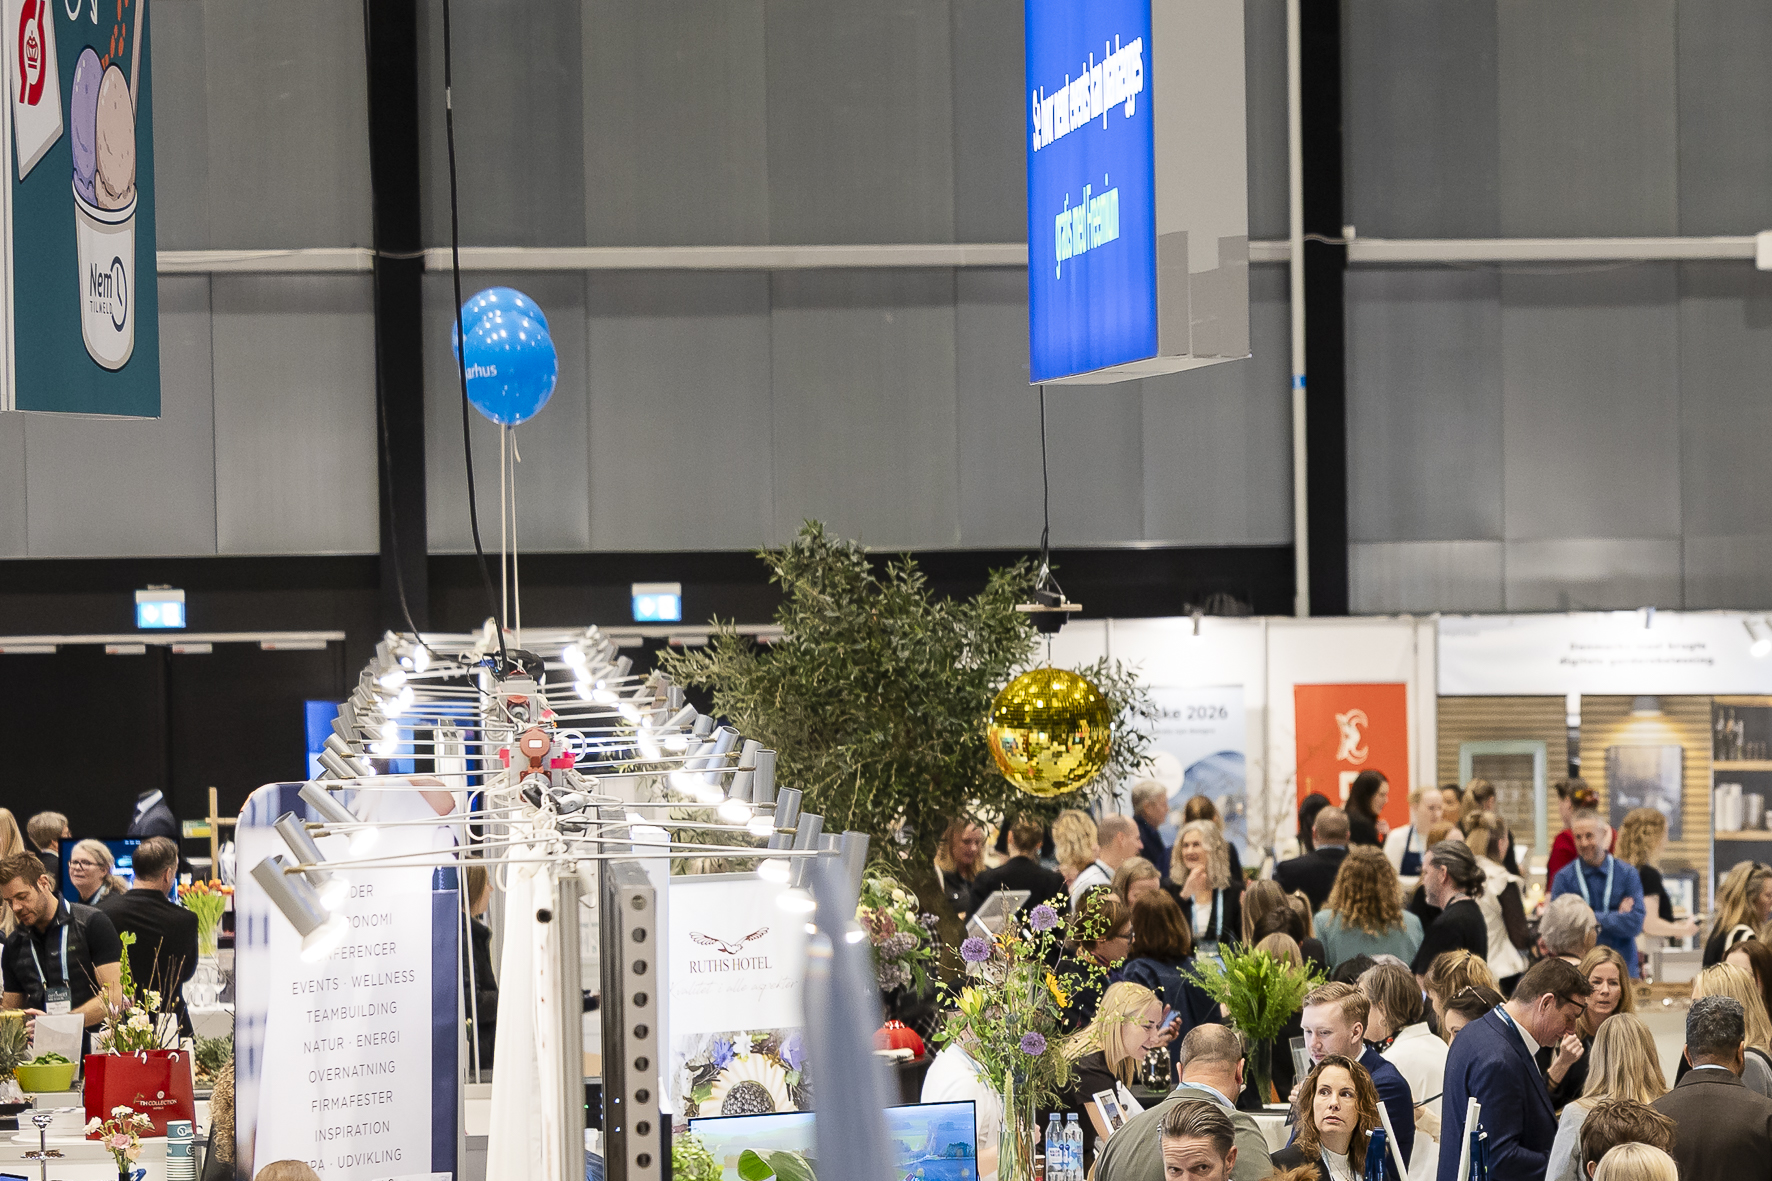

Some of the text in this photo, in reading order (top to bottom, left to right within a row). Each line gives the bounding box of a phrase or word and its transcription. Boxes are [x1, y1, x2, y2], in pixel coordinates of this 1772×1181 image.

[89, 263, 113, 299] Nem
[465, 363, 498, 381] arhus
[1187, 704, 1229, 721] 2026
[689, 956, 773, 974] RUTHS HOTEL
[292, 969, 416, 995] EVENTS WELLNESS
[306, 1001, 398, 1023] TEAMBUILDING
[303, 1030, 400, 1054] NATUR ENERGI
[308, 1060, 396, 1084] OVERNATNING
[311, 1090, 394, 1113] FIRMAFESTER
[314, 1120, 391, 1142] INSPIRATION
[337, 1148, 402, 1169] UDVIKLING
